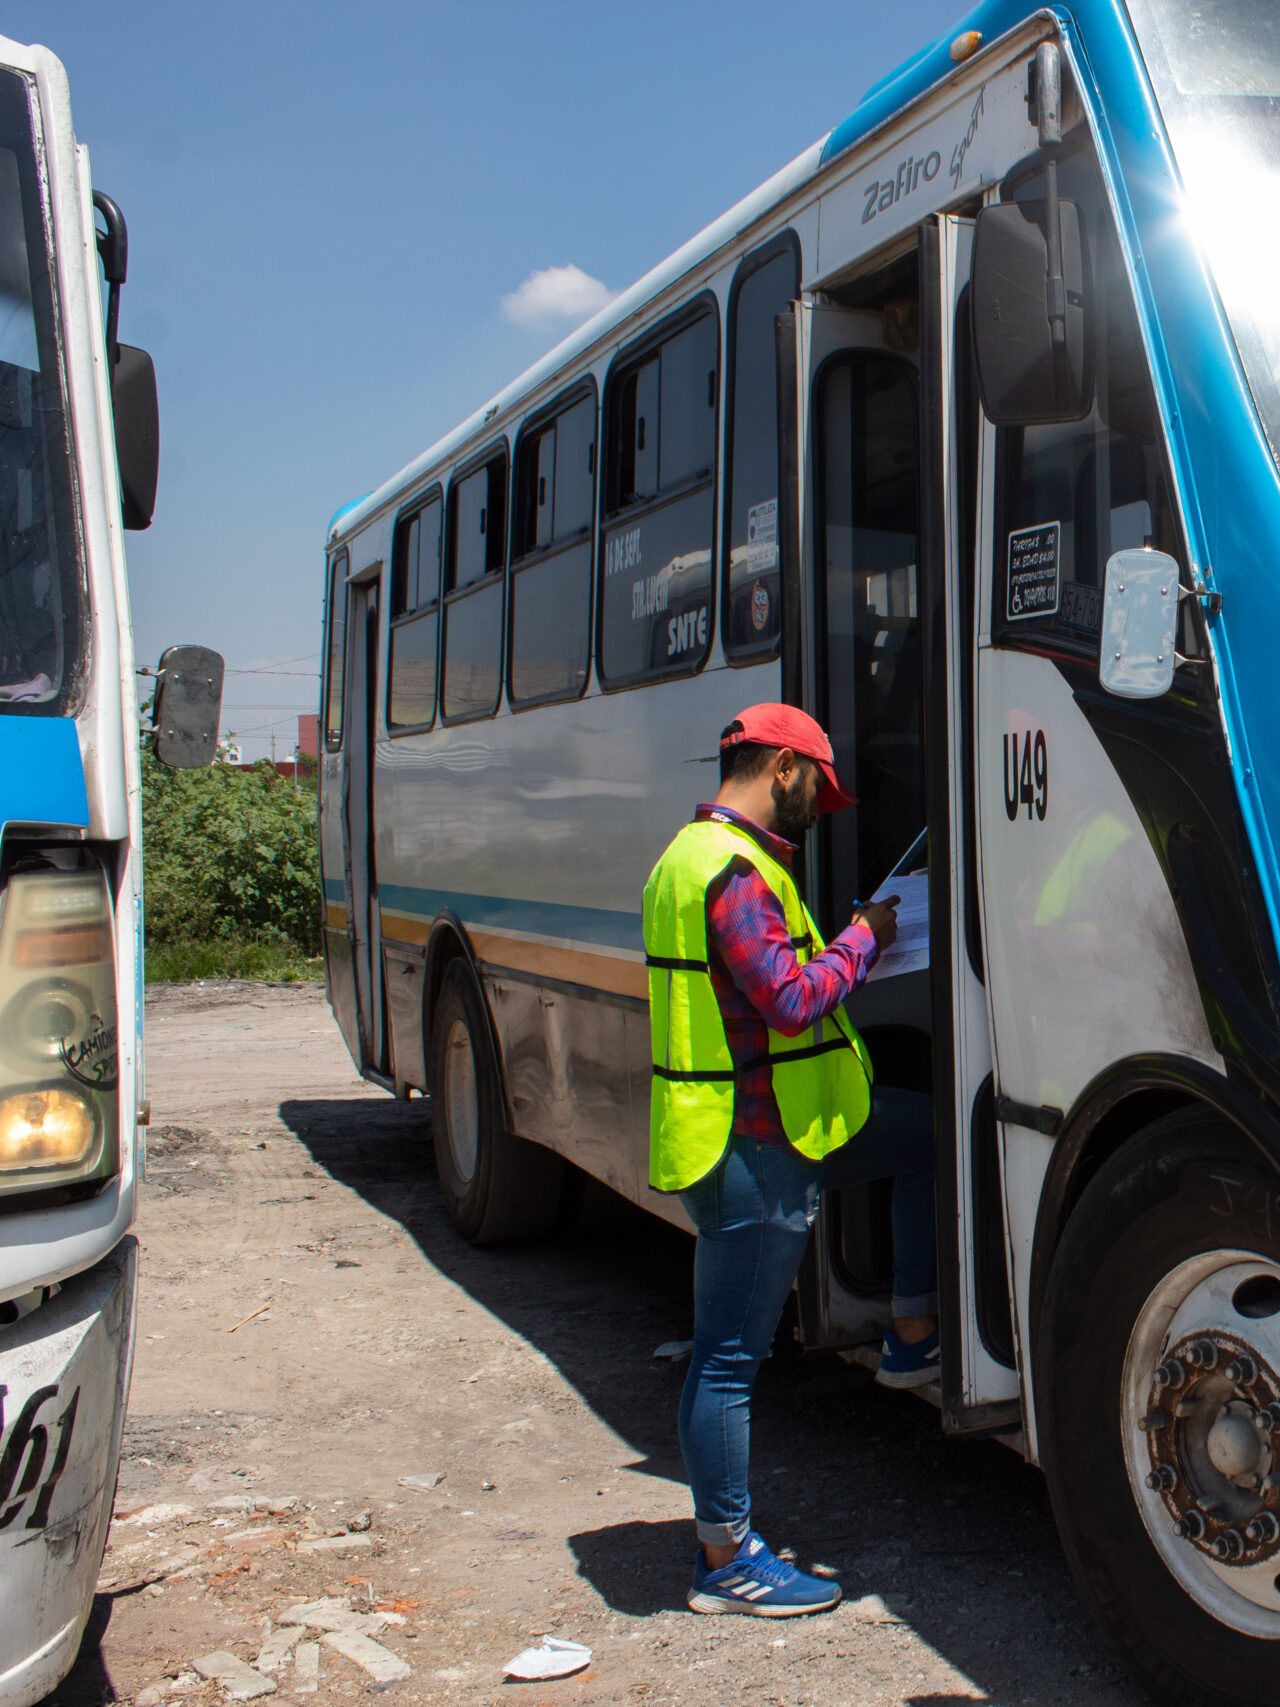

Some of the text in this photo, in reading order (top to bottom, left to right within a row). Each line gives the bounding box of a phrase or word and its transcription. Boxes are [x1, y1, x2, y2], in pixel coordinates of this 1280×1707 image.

[861, 150, 941, 225] Zafiro
[668, 607, 707, 656] SNTE
[1003, 729, 1048, 822] U49
[0, 1384, 81, 1529] 61
